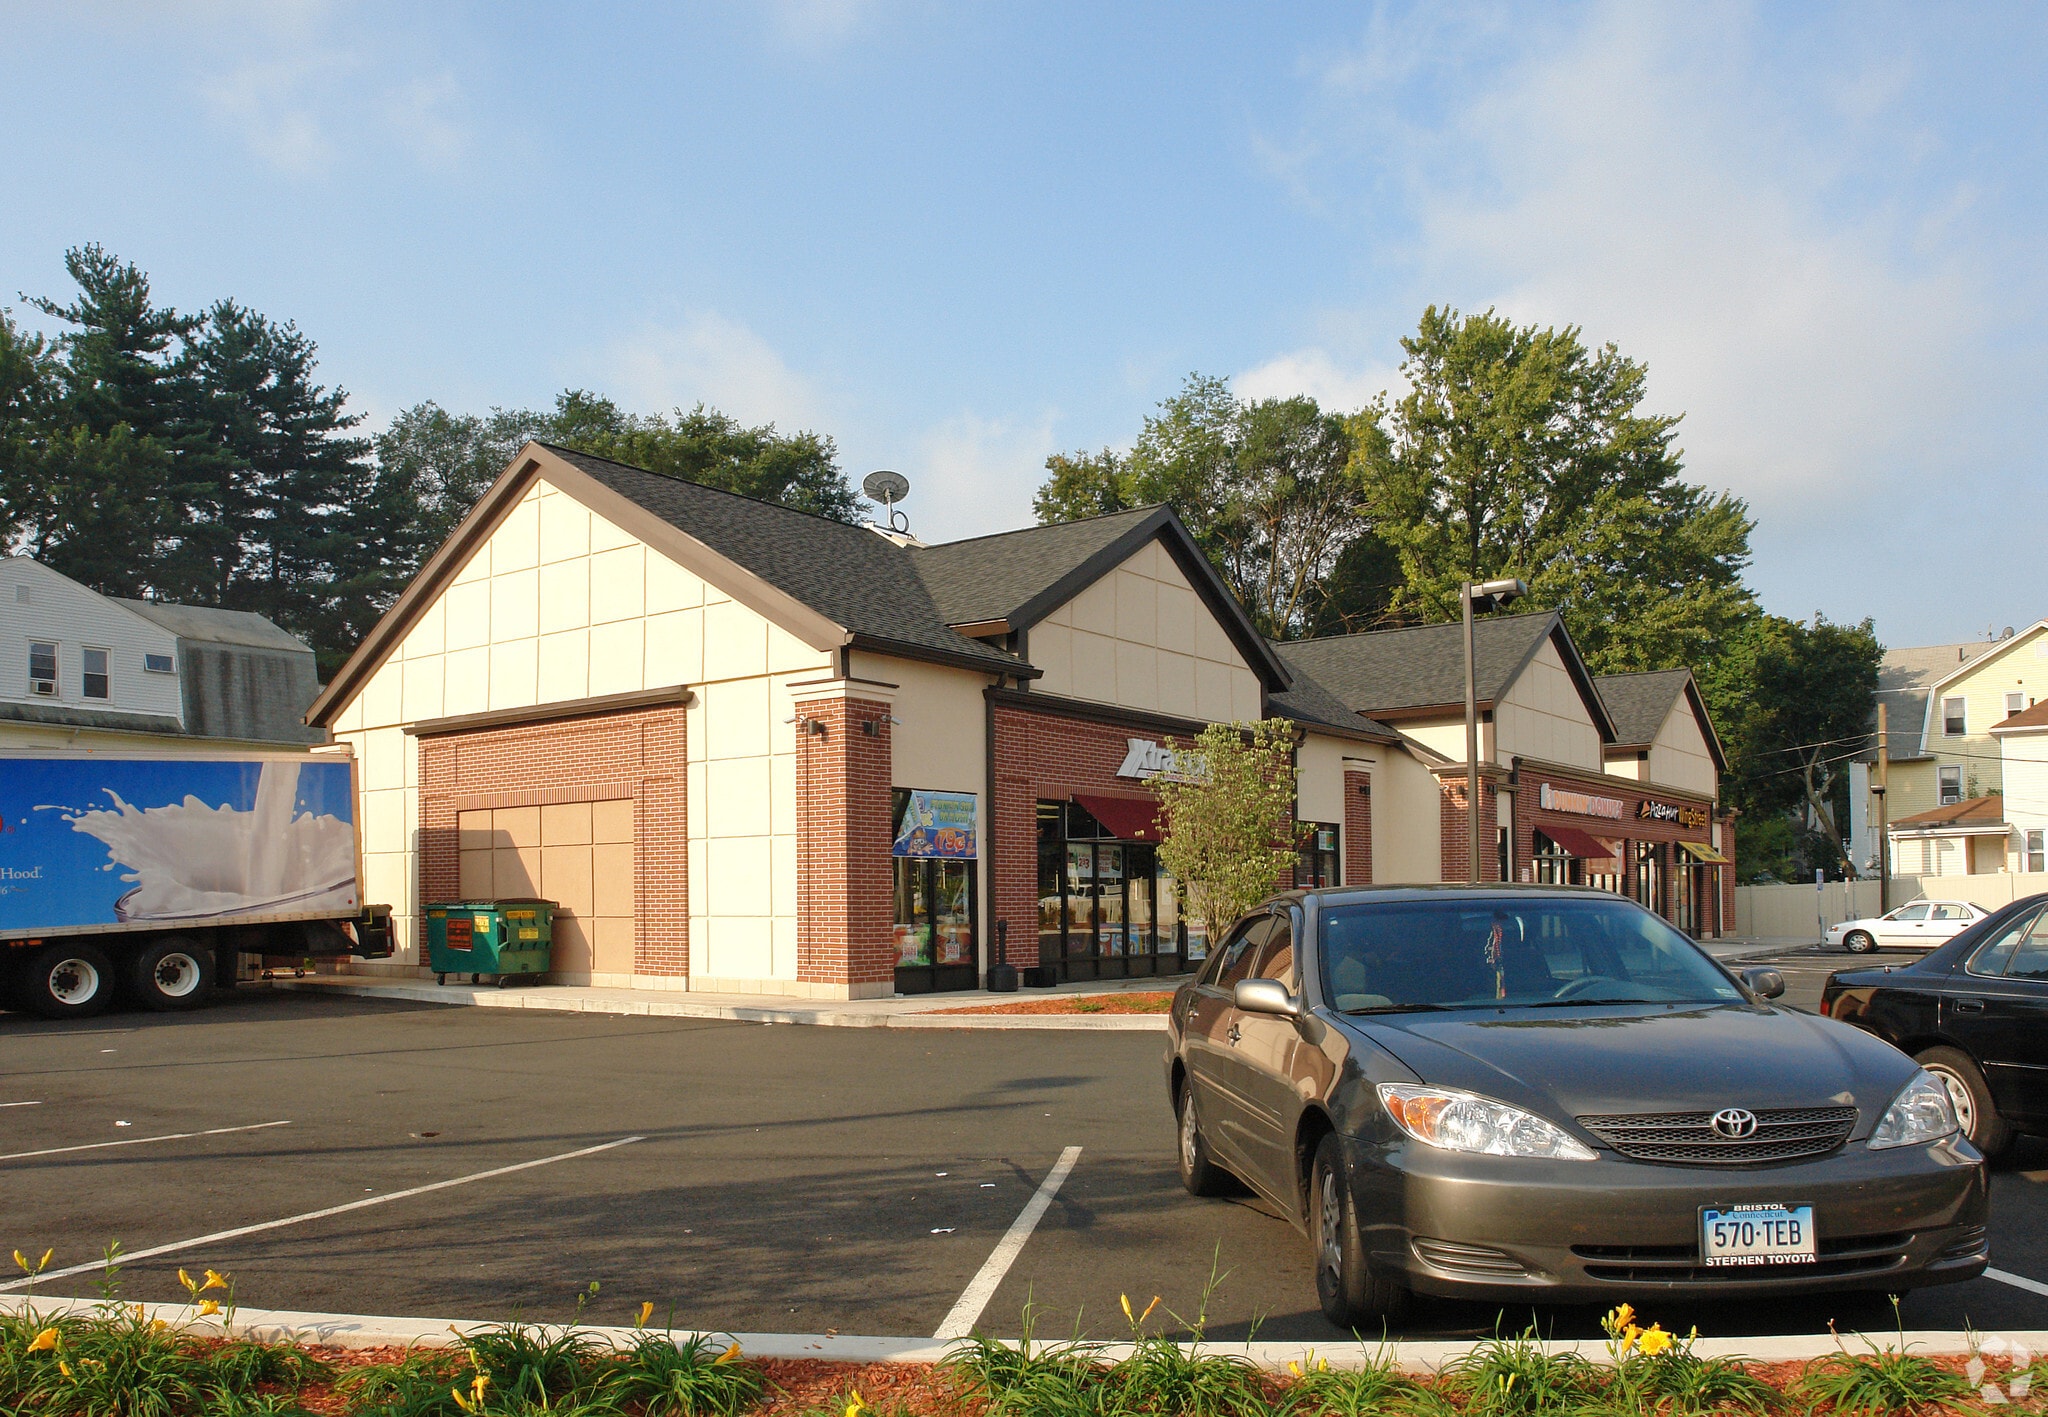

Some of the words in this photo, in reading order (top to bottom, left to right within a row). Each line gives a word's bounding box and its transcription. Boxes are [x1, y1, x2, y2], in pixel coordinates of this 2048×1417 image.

[1589, 796, 1624, 819] DONUTS
[1733, 1203, 1787, 1211] BRISTOL
[1706, 1256, 1764, 1266] STEPHEN
[1767, 1254, 1815, 1263] TOYOTA
